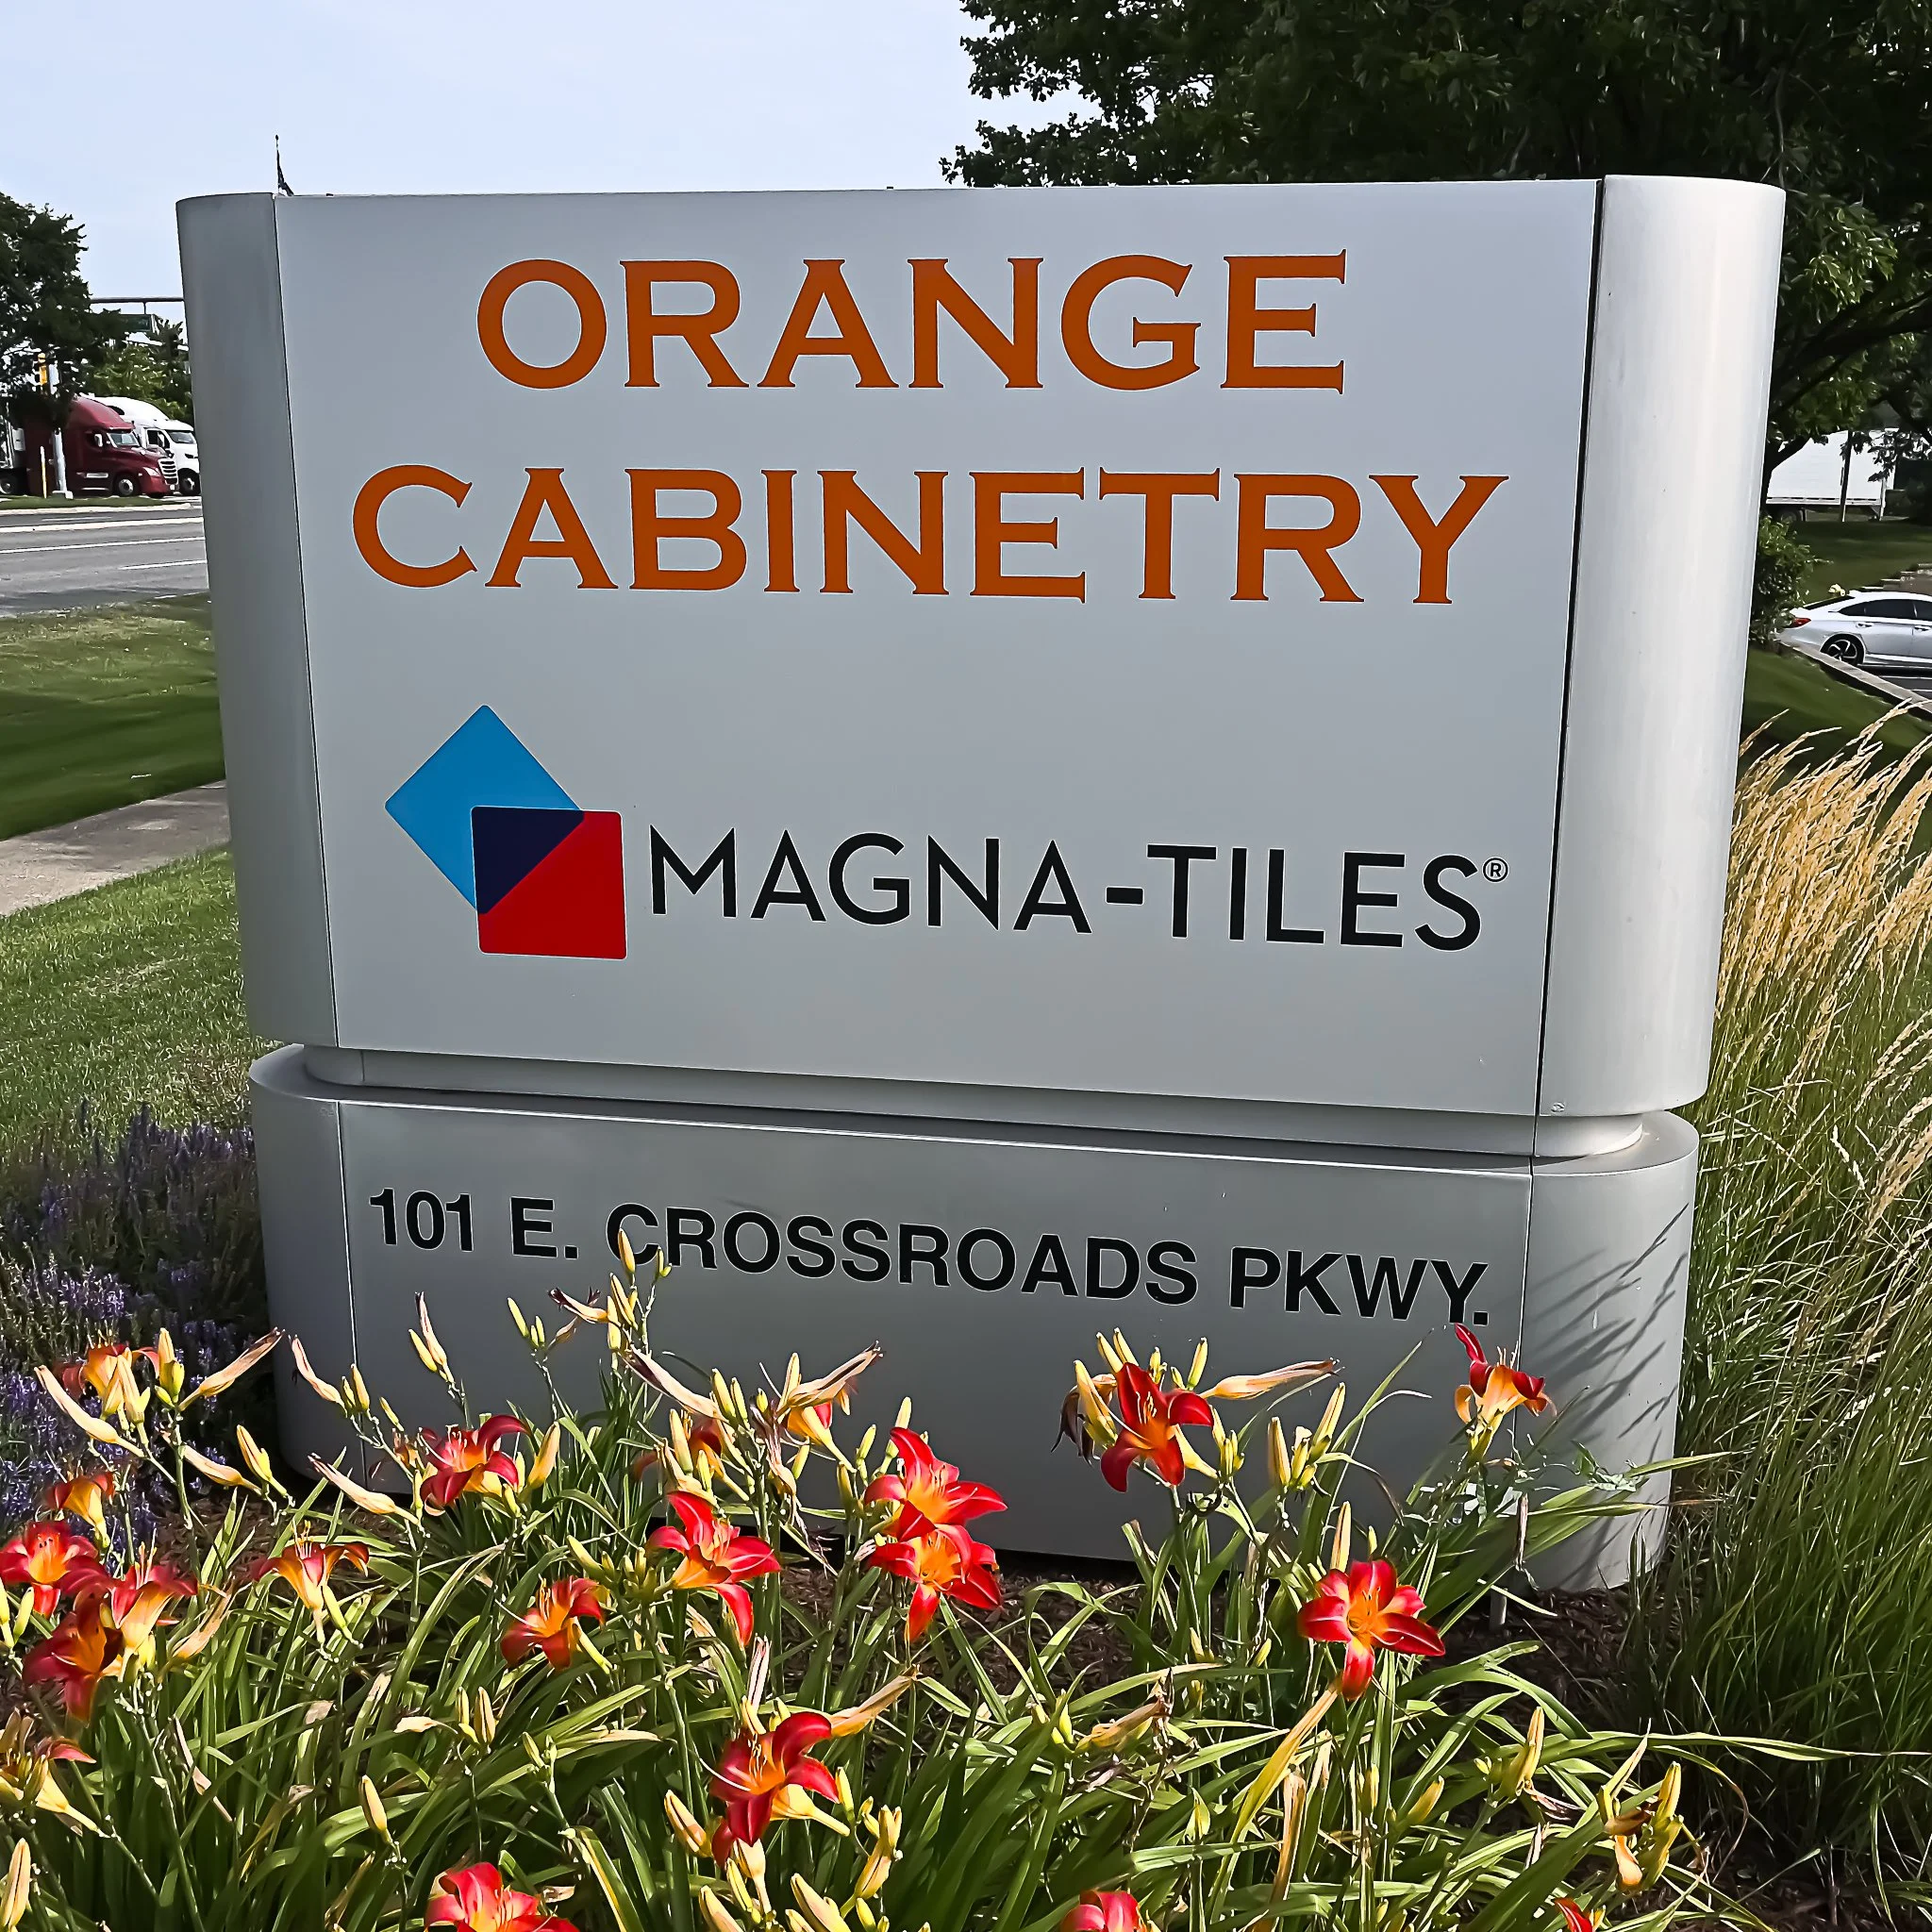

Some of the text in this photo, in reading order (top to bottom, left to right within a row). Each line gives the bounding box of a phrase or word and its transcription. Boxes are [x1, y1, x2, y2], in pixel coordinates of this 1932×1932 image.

[476, 250, 1346, 394] ORANGE
[352, 464, 1507, 605] CABINETRY
[370, 1187, 1490, 1327] 101 E. CROSSROADS PKWY.
